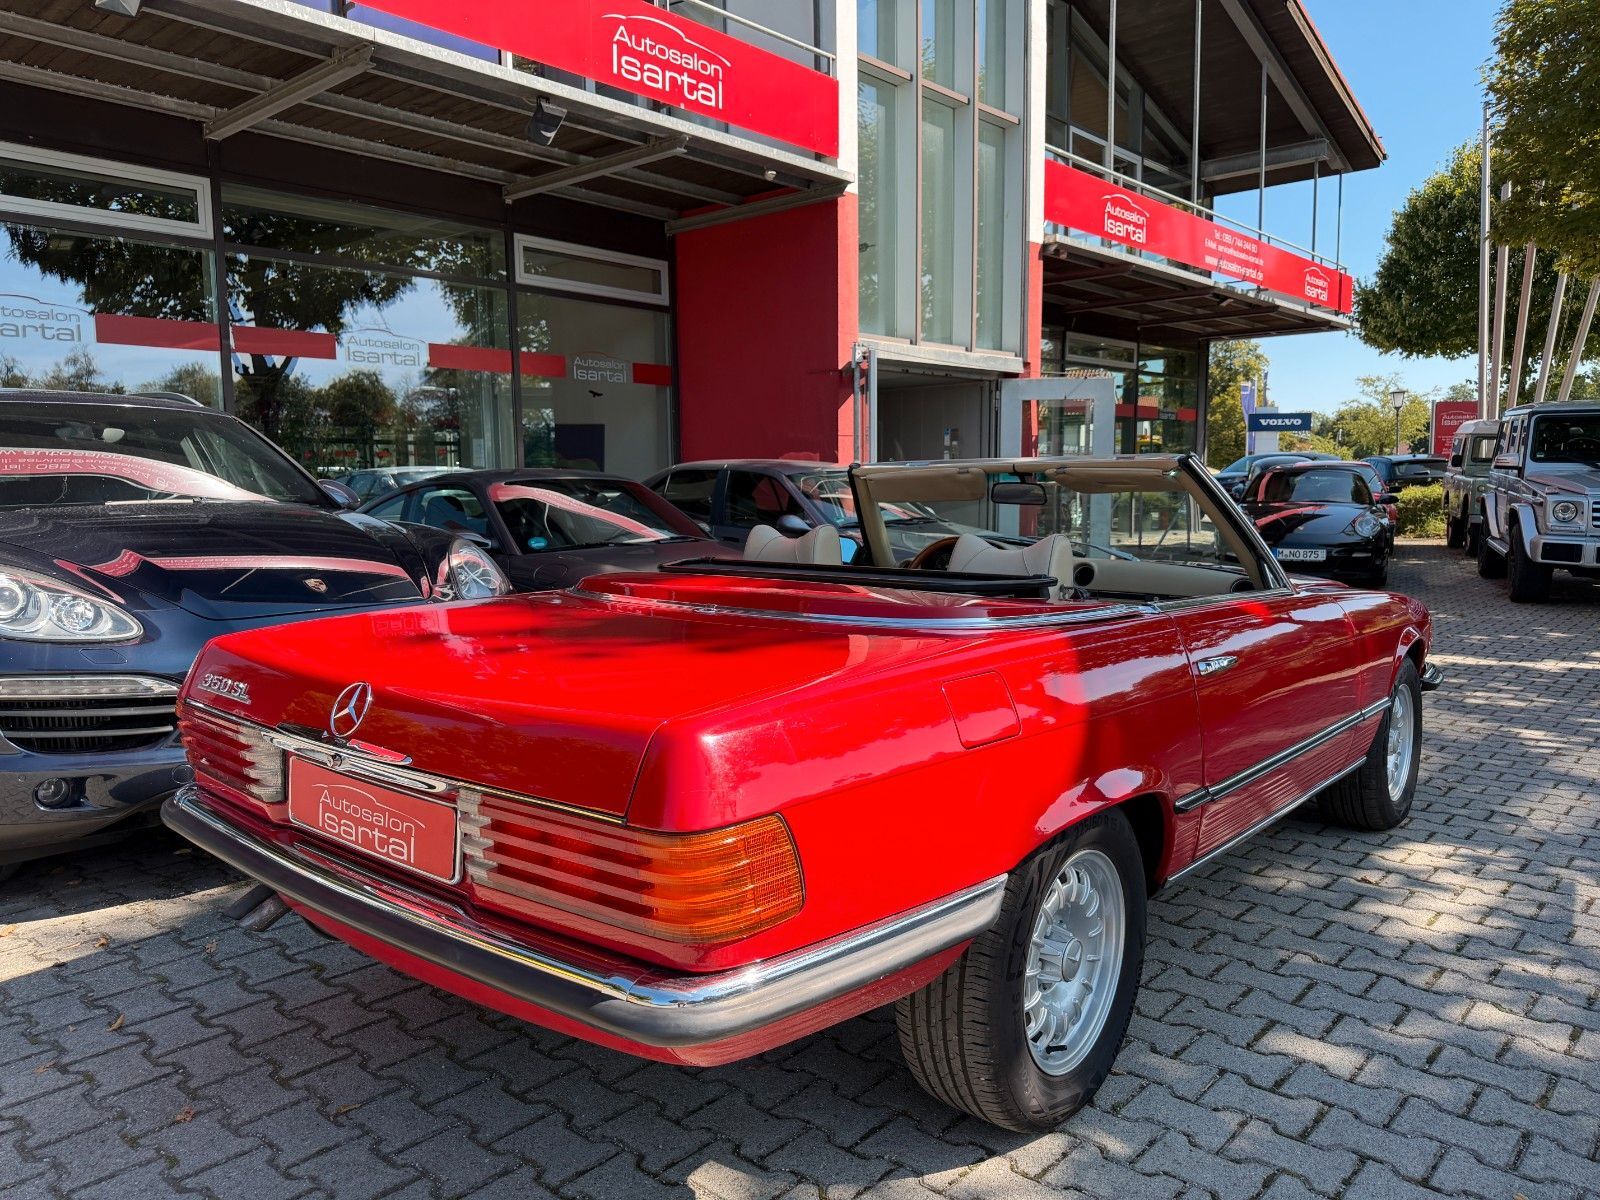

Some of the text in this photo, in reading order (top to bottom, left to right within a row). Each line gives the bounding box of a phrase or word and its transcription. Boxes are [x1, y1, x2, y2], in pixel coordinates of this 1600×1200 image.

[613, 25, 722, 79] Autosalon
[612, 43, 722, 109] Isartal
[1105, 201, 1146, 225] Autosalon
[1104, 212, 1146, 244] Isartal
[1304, 272, 1328, 289] Autosalon
[1304, 281, 1328, 302] Isartal
[0, 306, 80, 322] tosalon
[0, 322, 81, 342] artal
[347, 335, 420, 351] Autosalon
[347, 346, 420, 367] Isartal
[573, 356, 626, 370] Autosalon
[573, 365, 627, 384] Isartal
[1259, 418, 1302, 426] VOLVO
[1302, 550, 1319, 559] 875
[202, 673, 249, 699] 350 SL
[319, 789, 415, 836] Autosalon
[319, 802, 415, 863] Isartal
